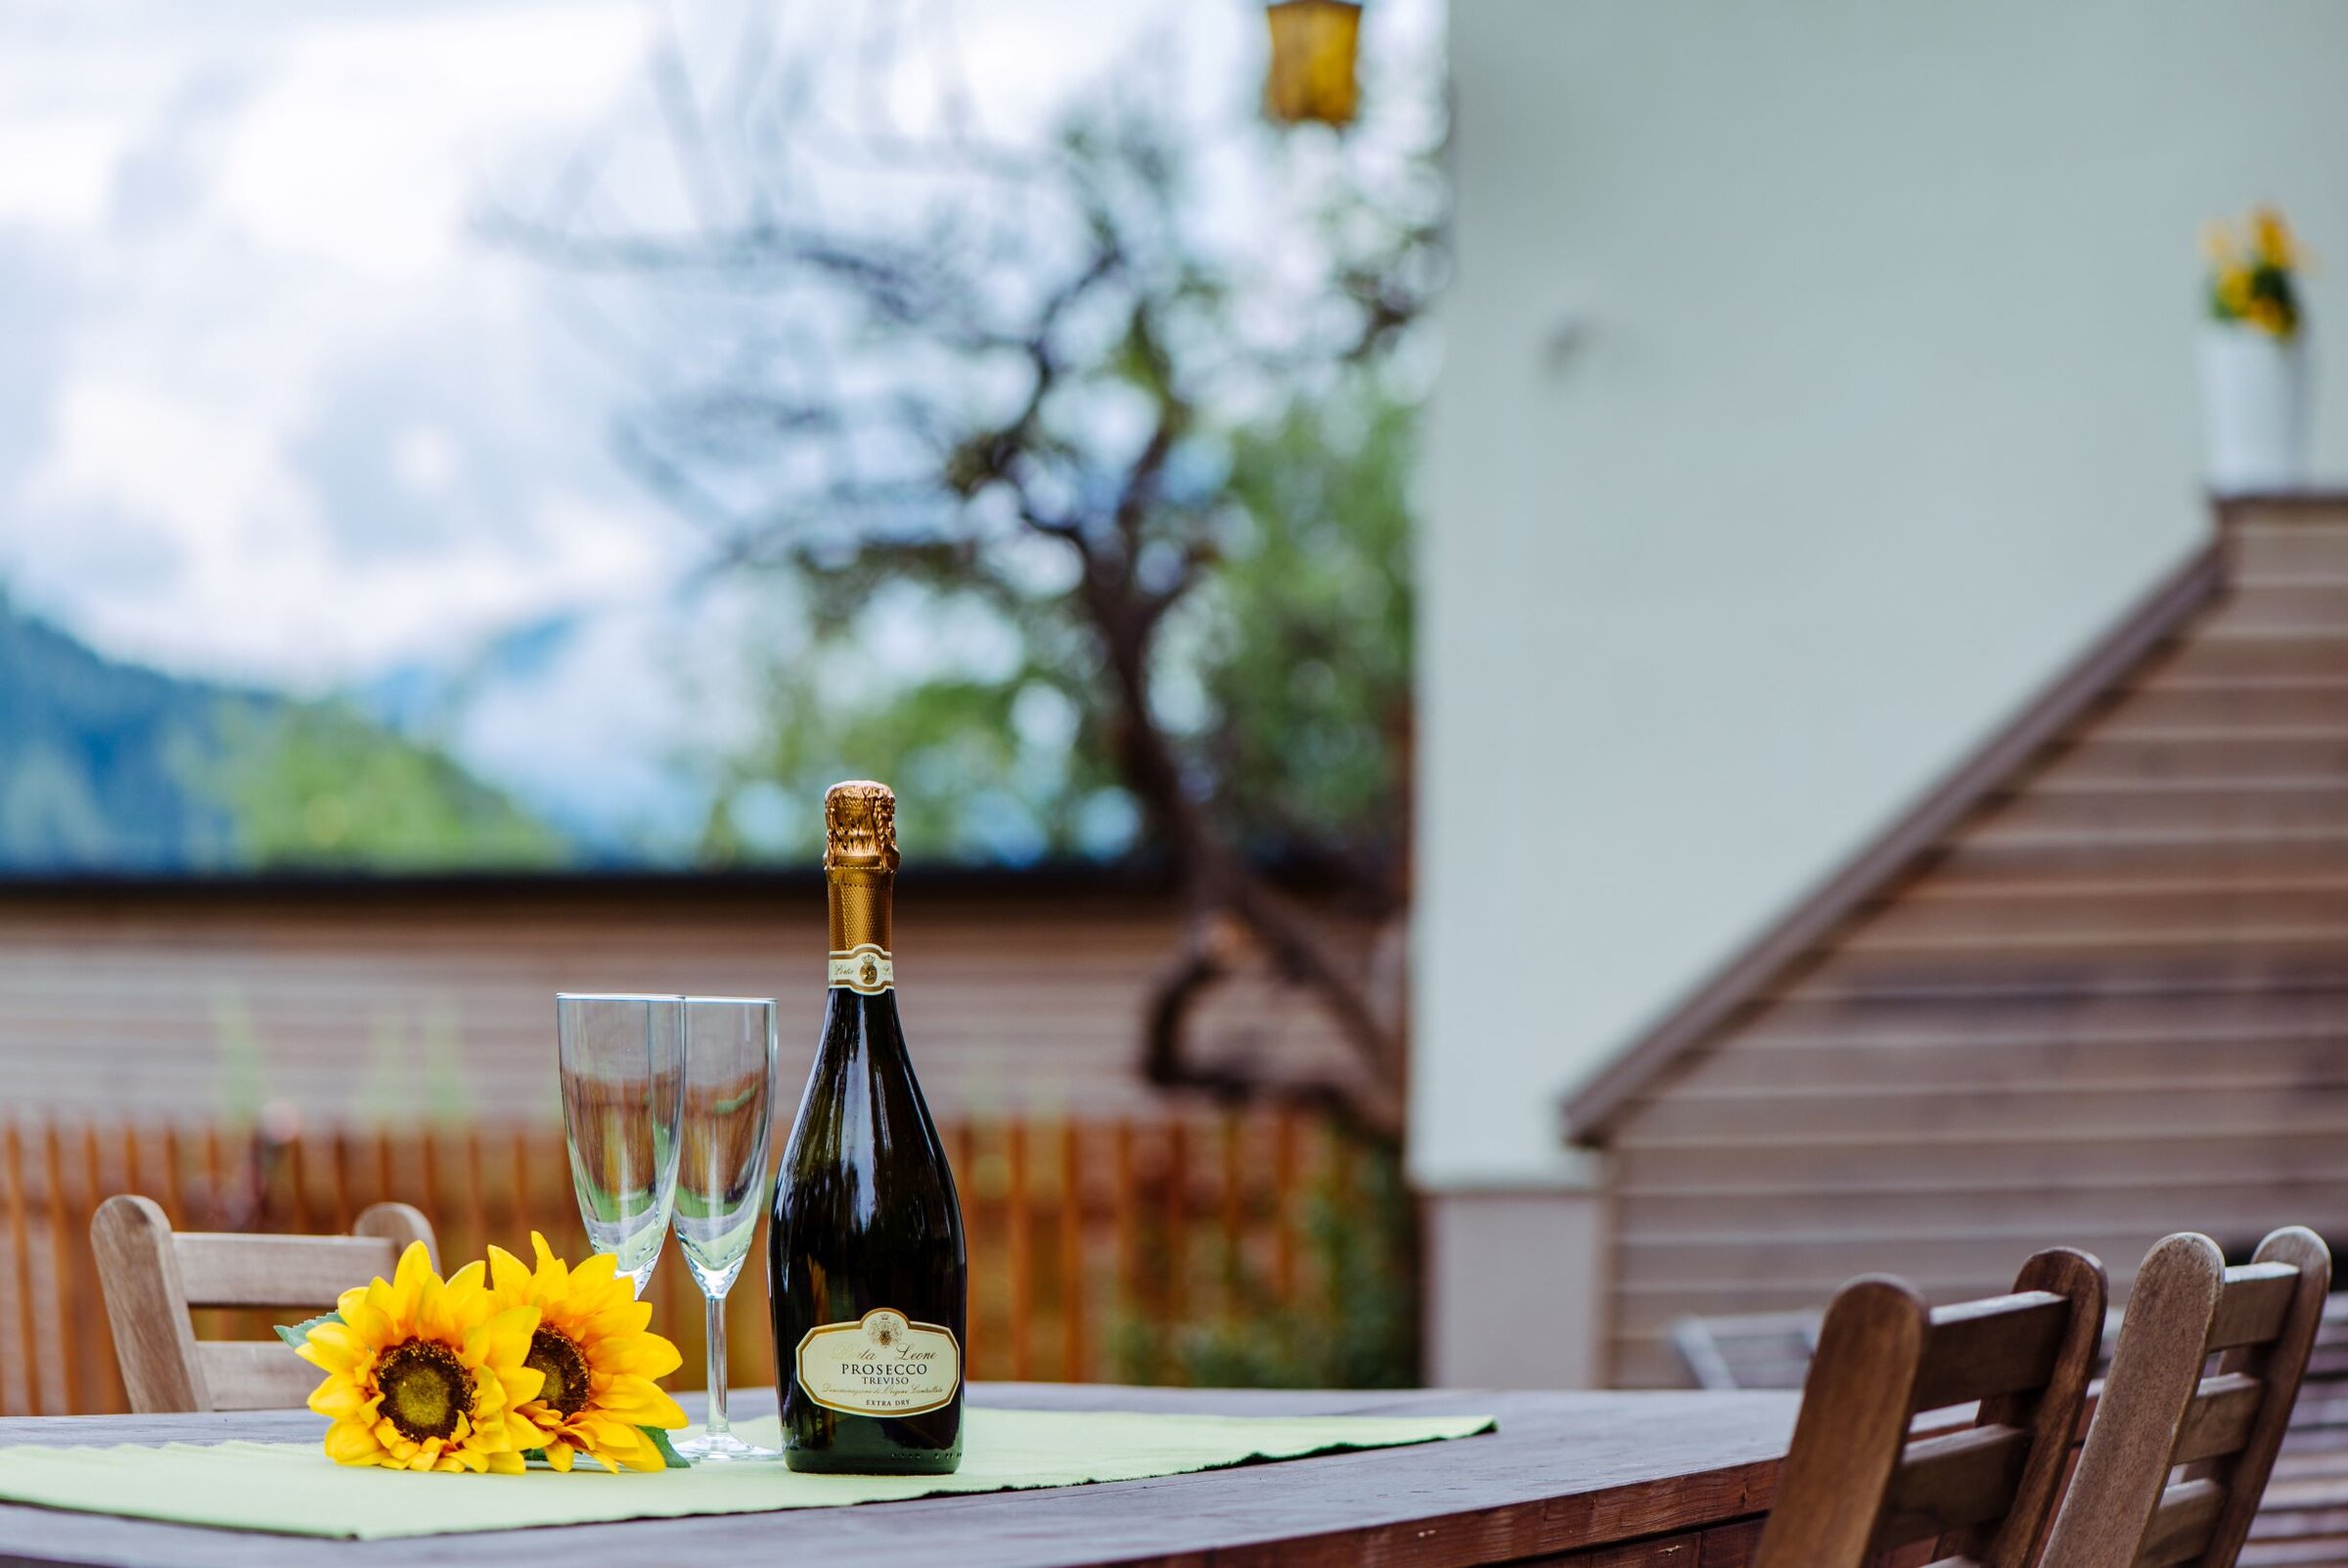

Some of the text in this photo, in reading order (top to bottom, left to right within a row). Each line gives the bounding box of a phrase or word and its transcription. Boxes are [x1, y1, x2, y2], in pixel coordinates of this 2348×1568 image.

[894, 1342, 937, 1361] Leone
[841, 1364, 927, 1376] PROSECCO
[862, 1376, 909, 1385] TREVISO
